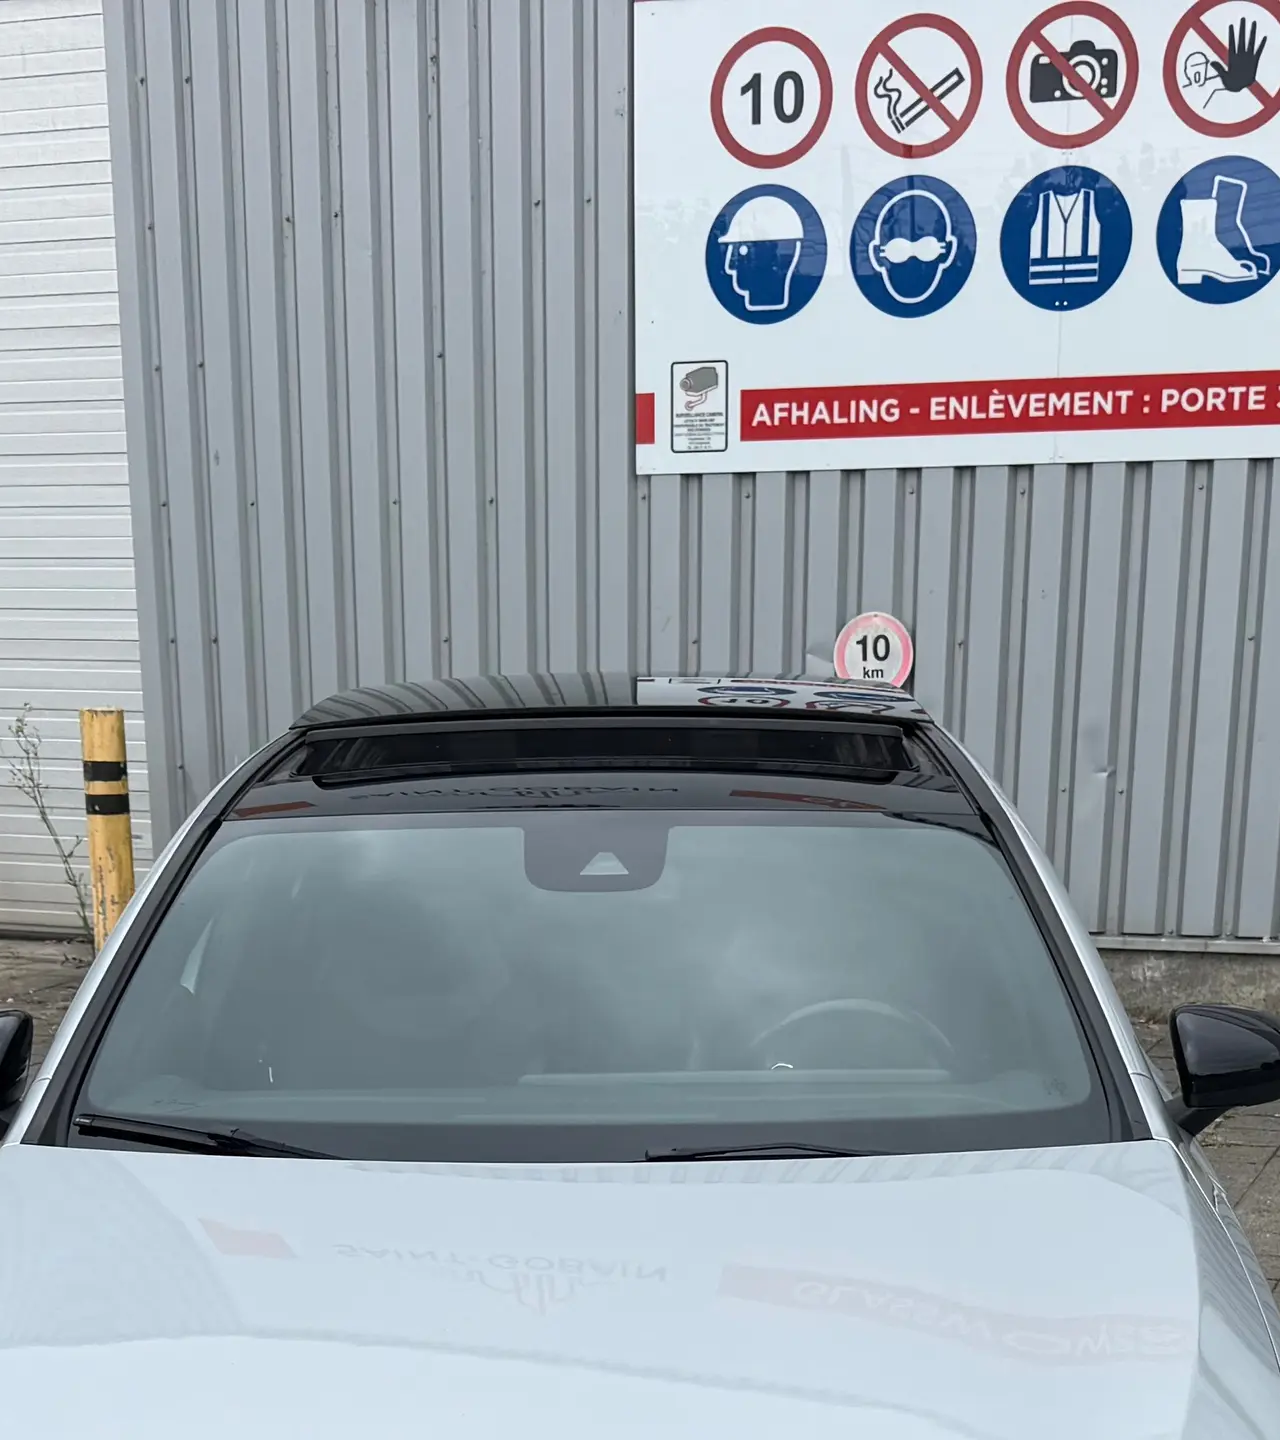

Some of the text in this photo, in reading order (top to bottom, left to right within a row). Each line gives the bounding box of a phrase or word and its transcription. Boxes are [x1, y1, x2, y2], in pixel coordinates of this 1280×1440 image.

[740, 72, 804, 126] 10
[752, 400, 900, 426] AFHALING
[929, 390, 1132, 420] ENLÈVEMENT
[1162, 386, 1266, 412] PORTE
[855, 634, 890, 662] 10
[862, 667, 884, 679] km
